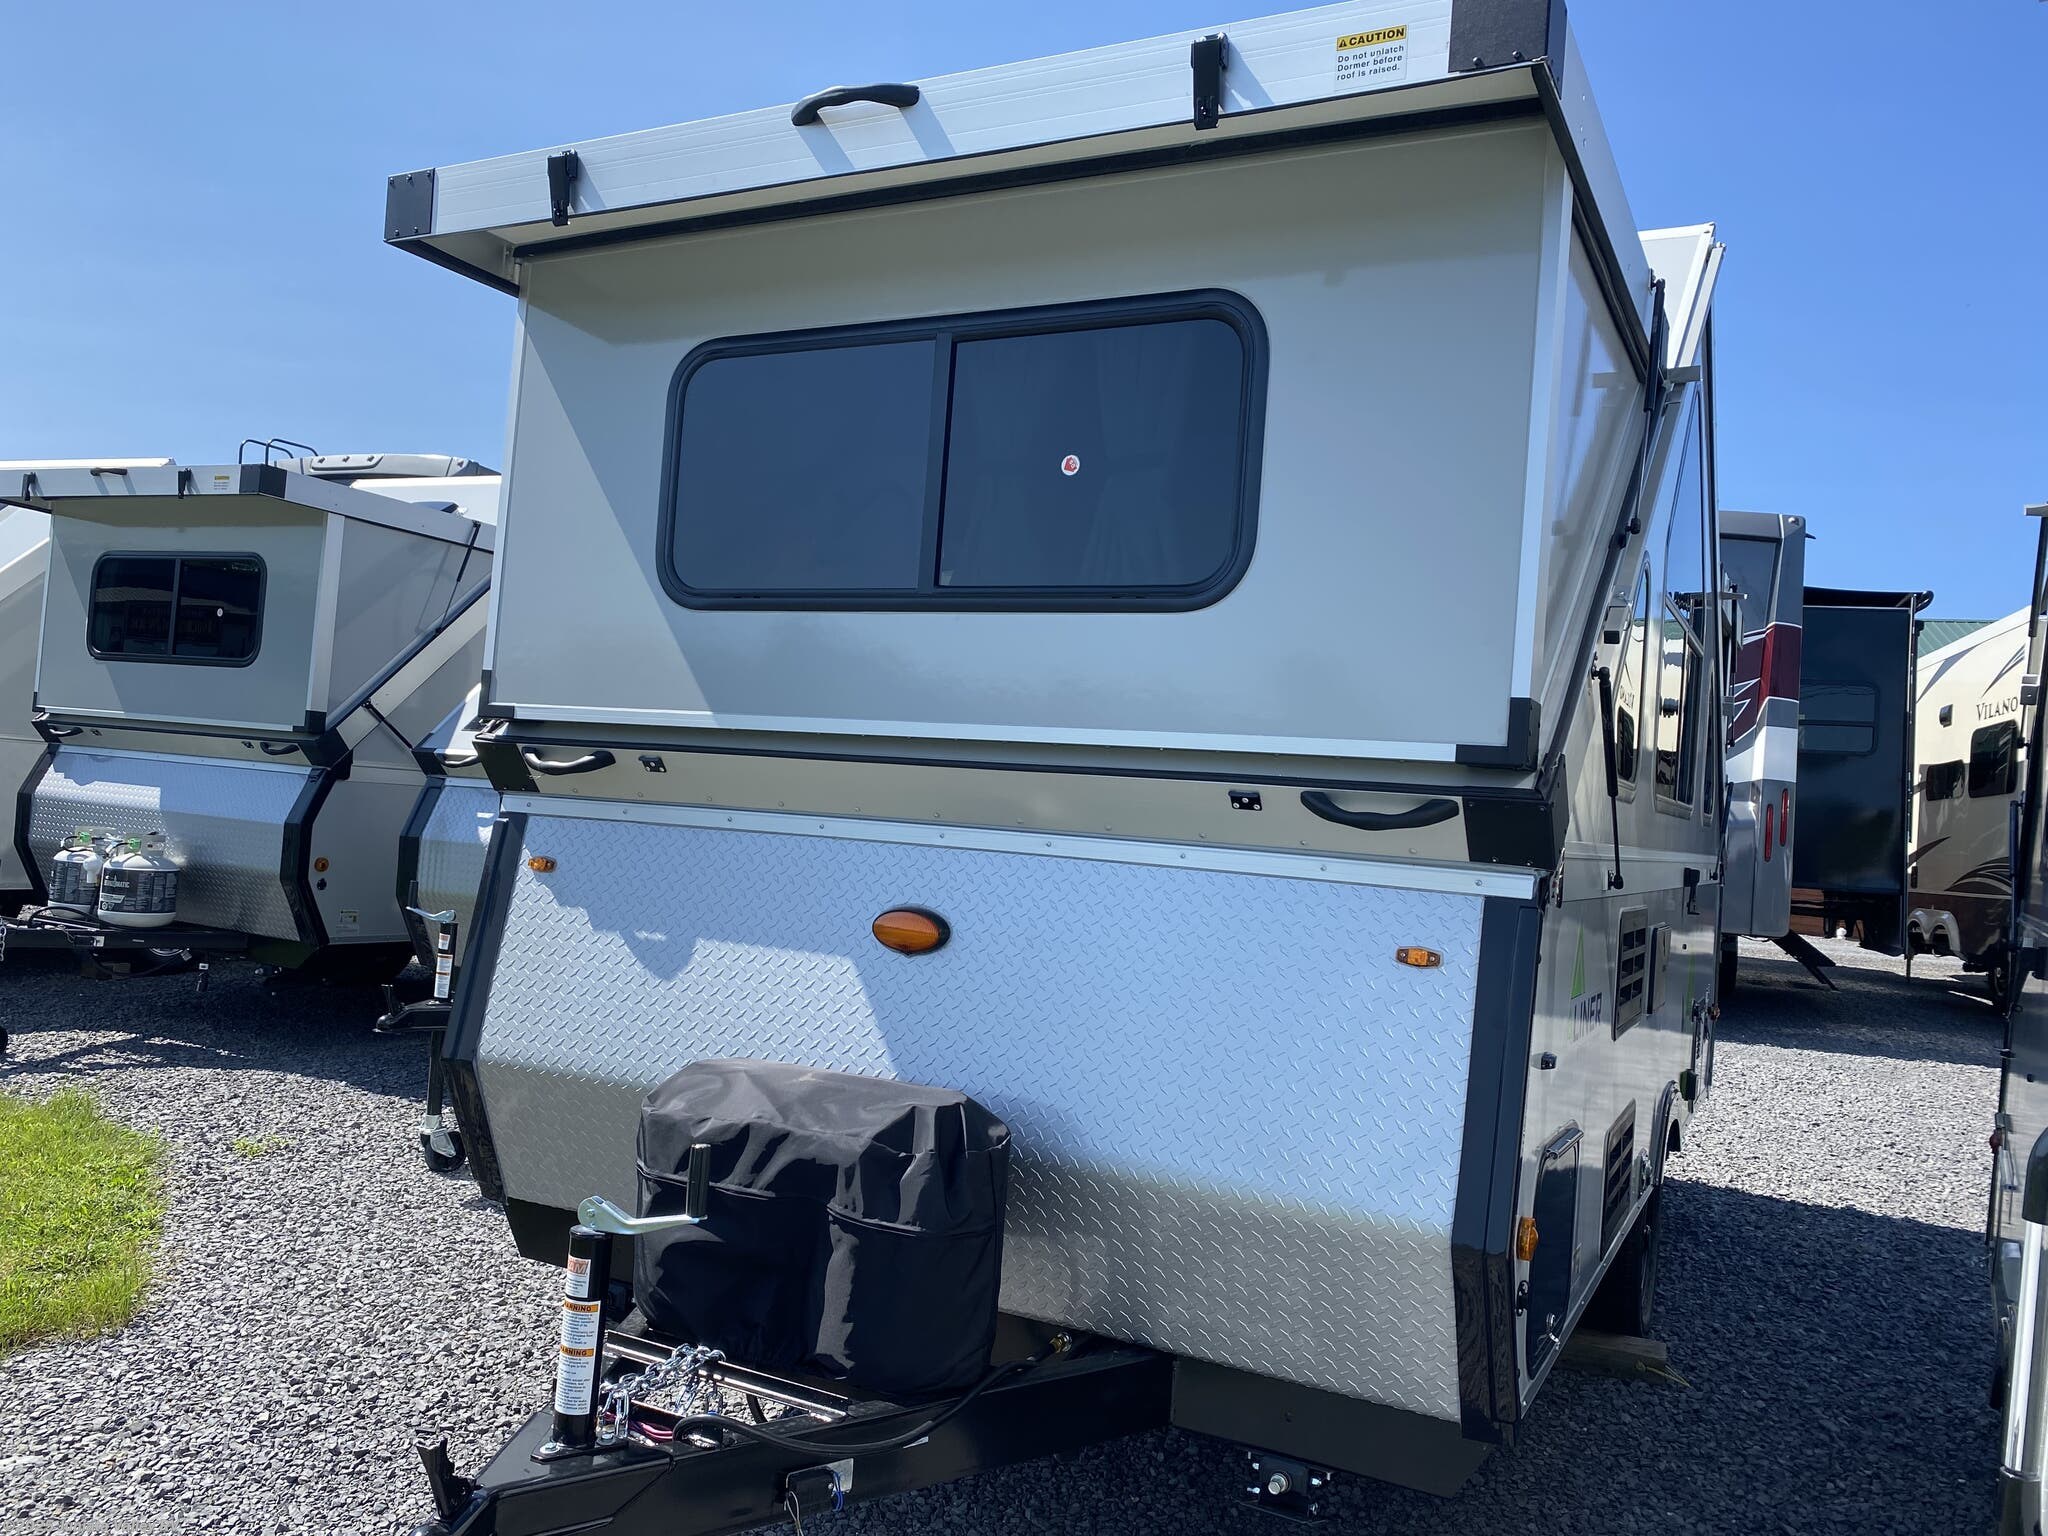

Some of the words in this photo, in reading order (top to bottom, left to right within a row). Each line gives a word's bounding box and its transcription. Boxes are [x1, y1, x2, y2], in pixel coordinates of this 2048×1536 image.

[1349, 28, 1404, 46] CAUTION
[1337, 55, 1349, 63] Do
[1352, 52, 1367, 60] not
[1370, 45, 1404, 57] unlatch
[1336, 72, 1355, 80] roof
[1369, 64, 1400, 75] raised.
[1337, 61, 1370, 72] Dormer
[1373, 55, 1402, 65] before
